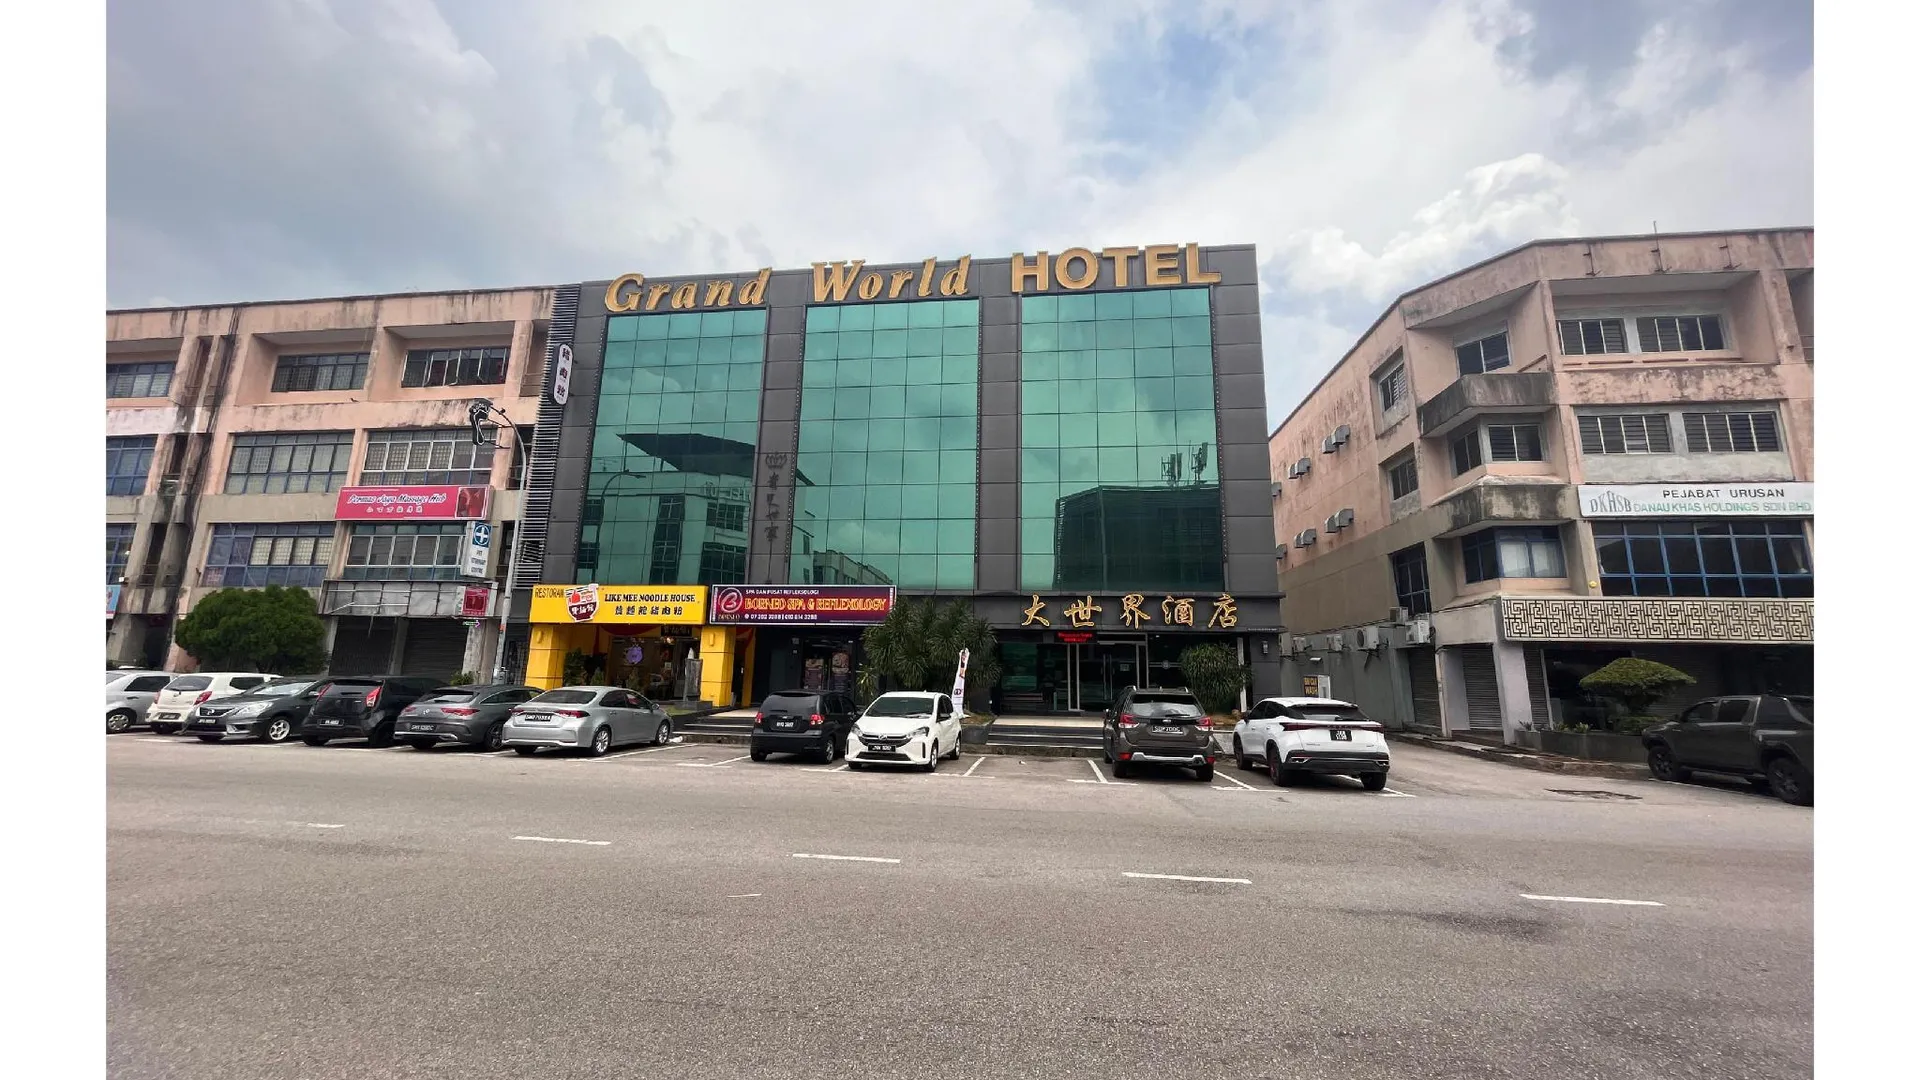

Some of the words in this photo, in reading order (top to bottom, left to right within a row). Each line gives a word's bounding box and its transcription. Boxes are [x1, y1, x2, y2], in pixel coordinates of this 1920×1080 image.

[604, 266, 772, 313] Grand
[811, 254, 971, 302] World
[1011, 242, 1222, 293] HOTEL
[1663, 489, 1721, 498] PEJABAT
[1729, 489, 1785, 498] URUSAN
[1590, 490, 1632, 513] DKHSB
[1633, 502, 1670, 512] DANAU
[1671, 502, 1701, 512] KHAS
[1703, 502, 1760, 512] HOLDINGS
[1763, 502, 1786, 512] SDN
[1789, 502, 1812, 512] BHD
[604, 594, 622, 602] LIKE
[622, 594, 638, 602] MEE
[639, 594, 669, 602] NOODLE
[669, 594, 695, 602] HOUSE
[744, 597, 787, 610] BORNEO
[787, 598, 806, 610] SPA
[816, 598, 886, 611] REFLEXOLOGY
[1021, 593, 1238, 630] 大世界酒店
